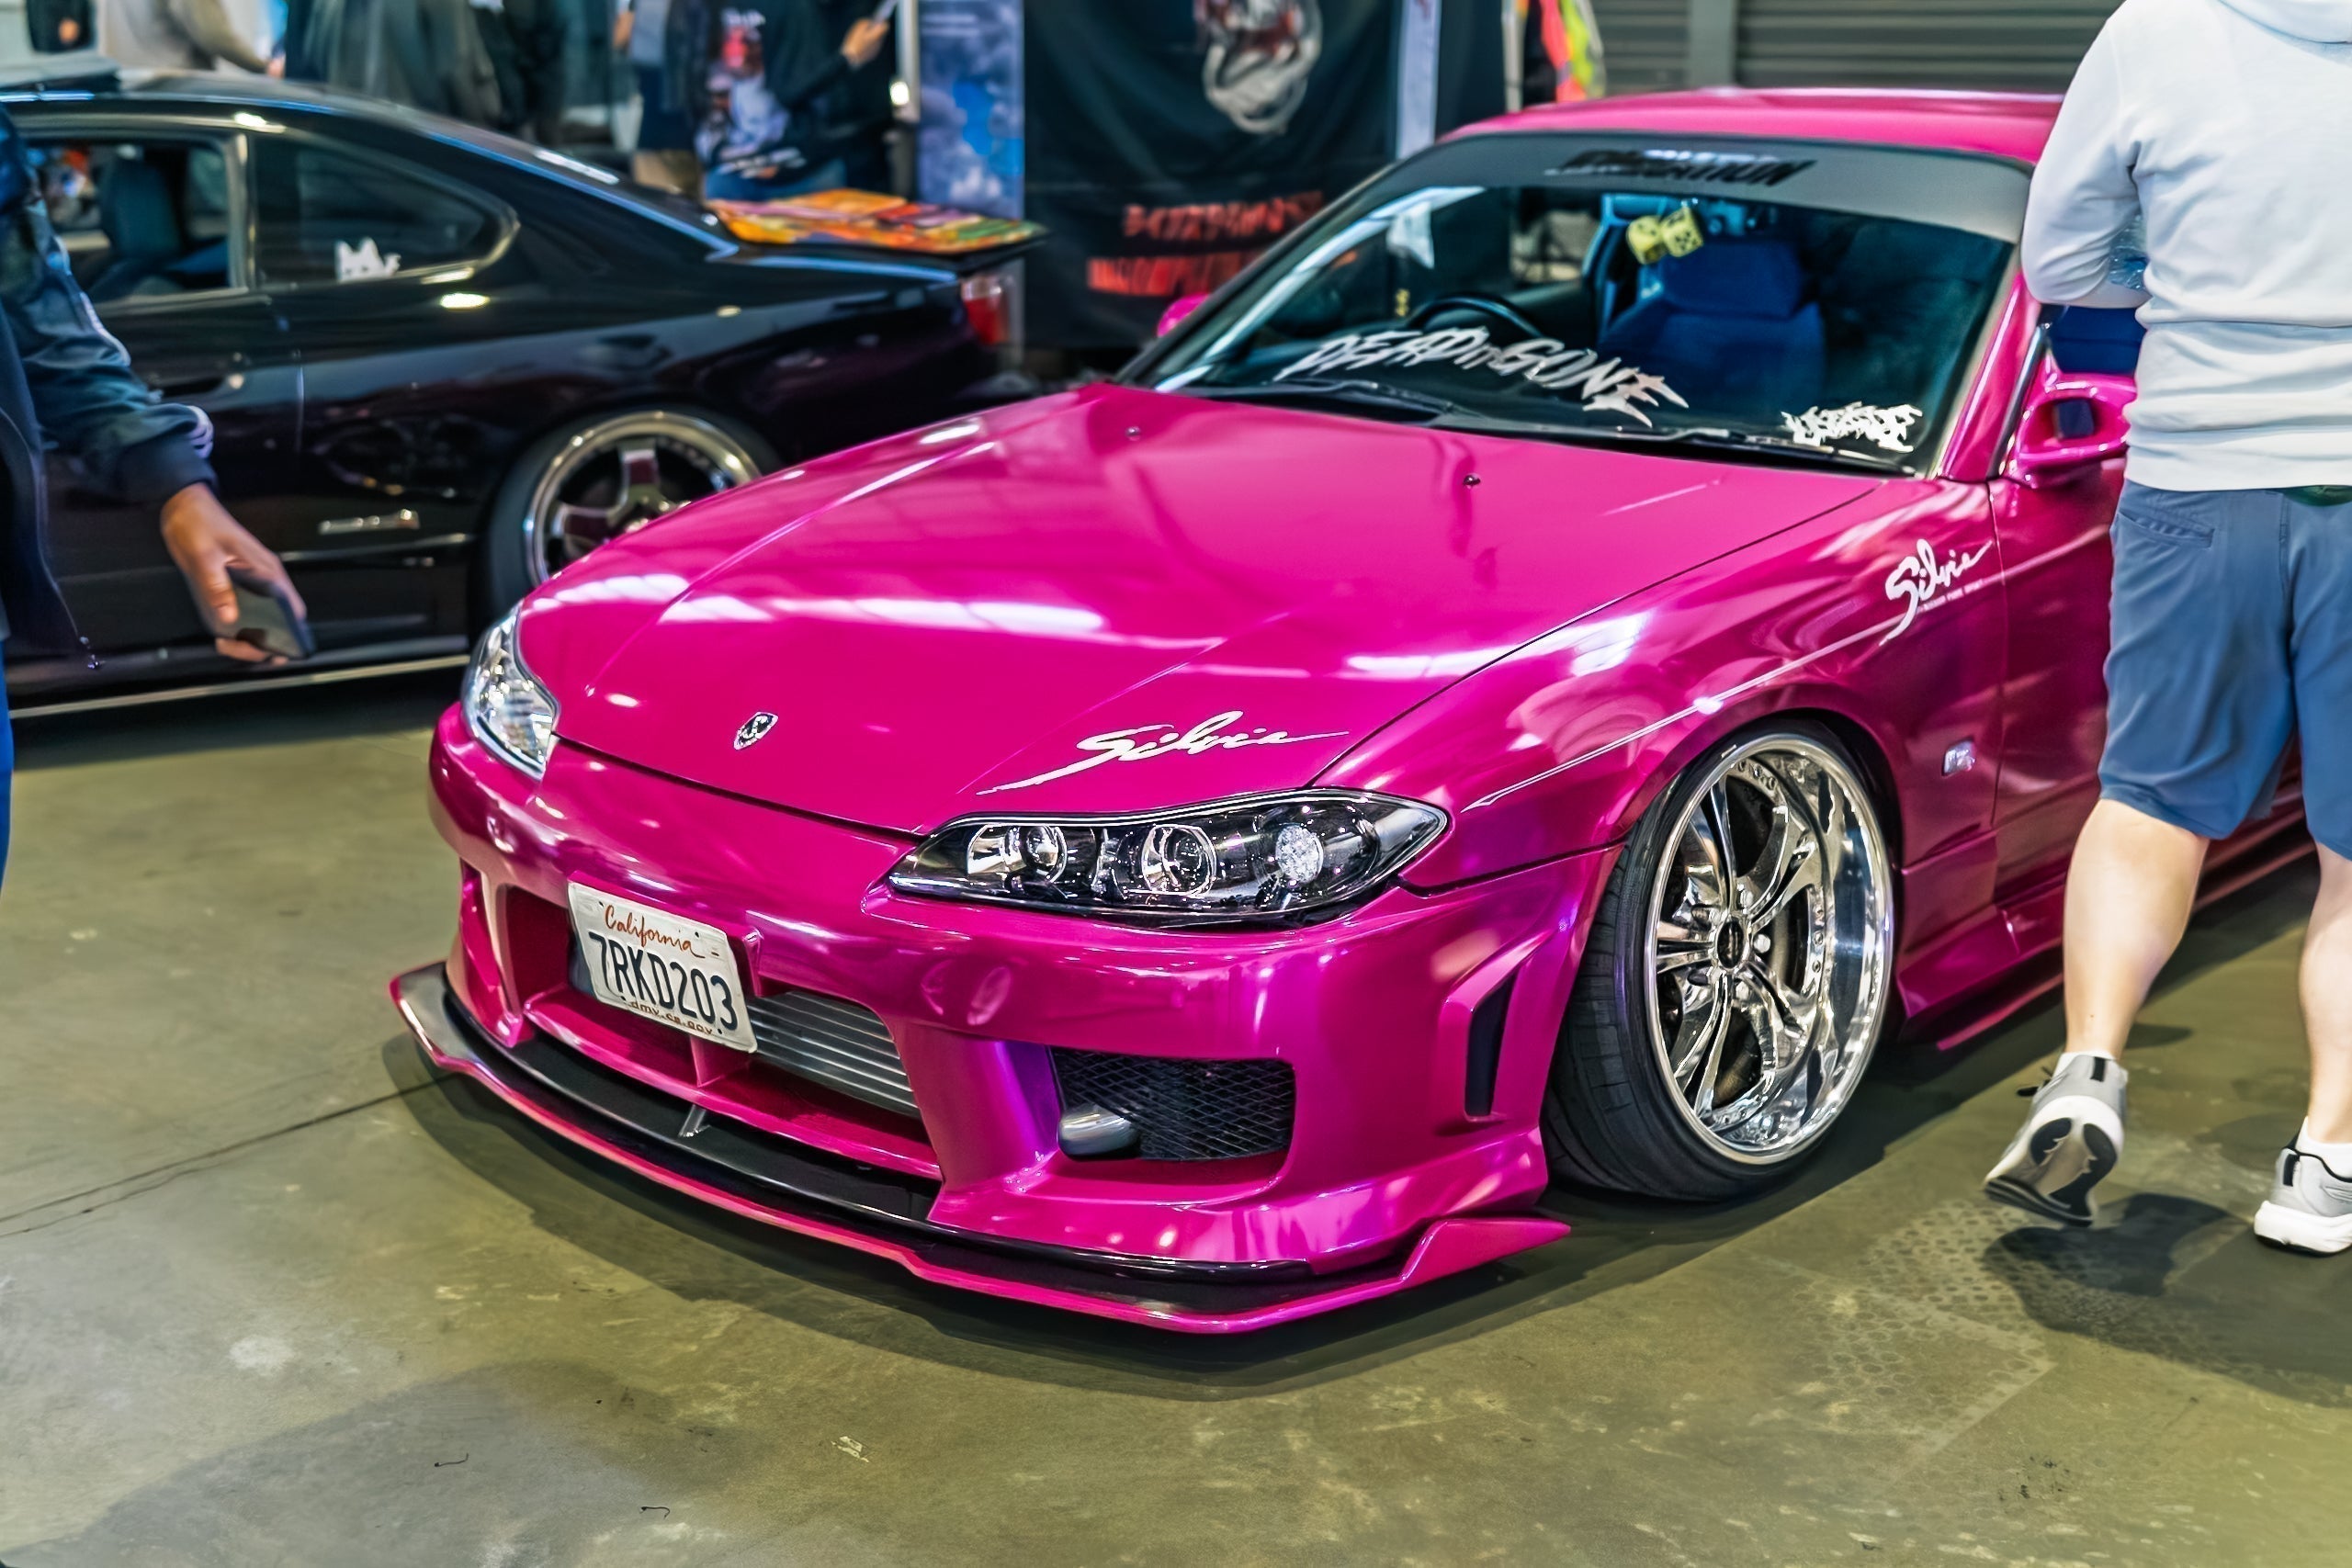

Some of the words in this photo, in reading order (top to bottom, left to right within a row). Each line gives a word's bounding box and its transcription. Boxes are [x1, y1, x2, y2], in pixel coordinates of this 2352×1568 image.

[1878, 538, 1993, 647] Silvia
[976, 710, 1349, 795] Silvia
[604, 904, 706, 959] California
[589, 931, 739, 1032] 7RKD203
